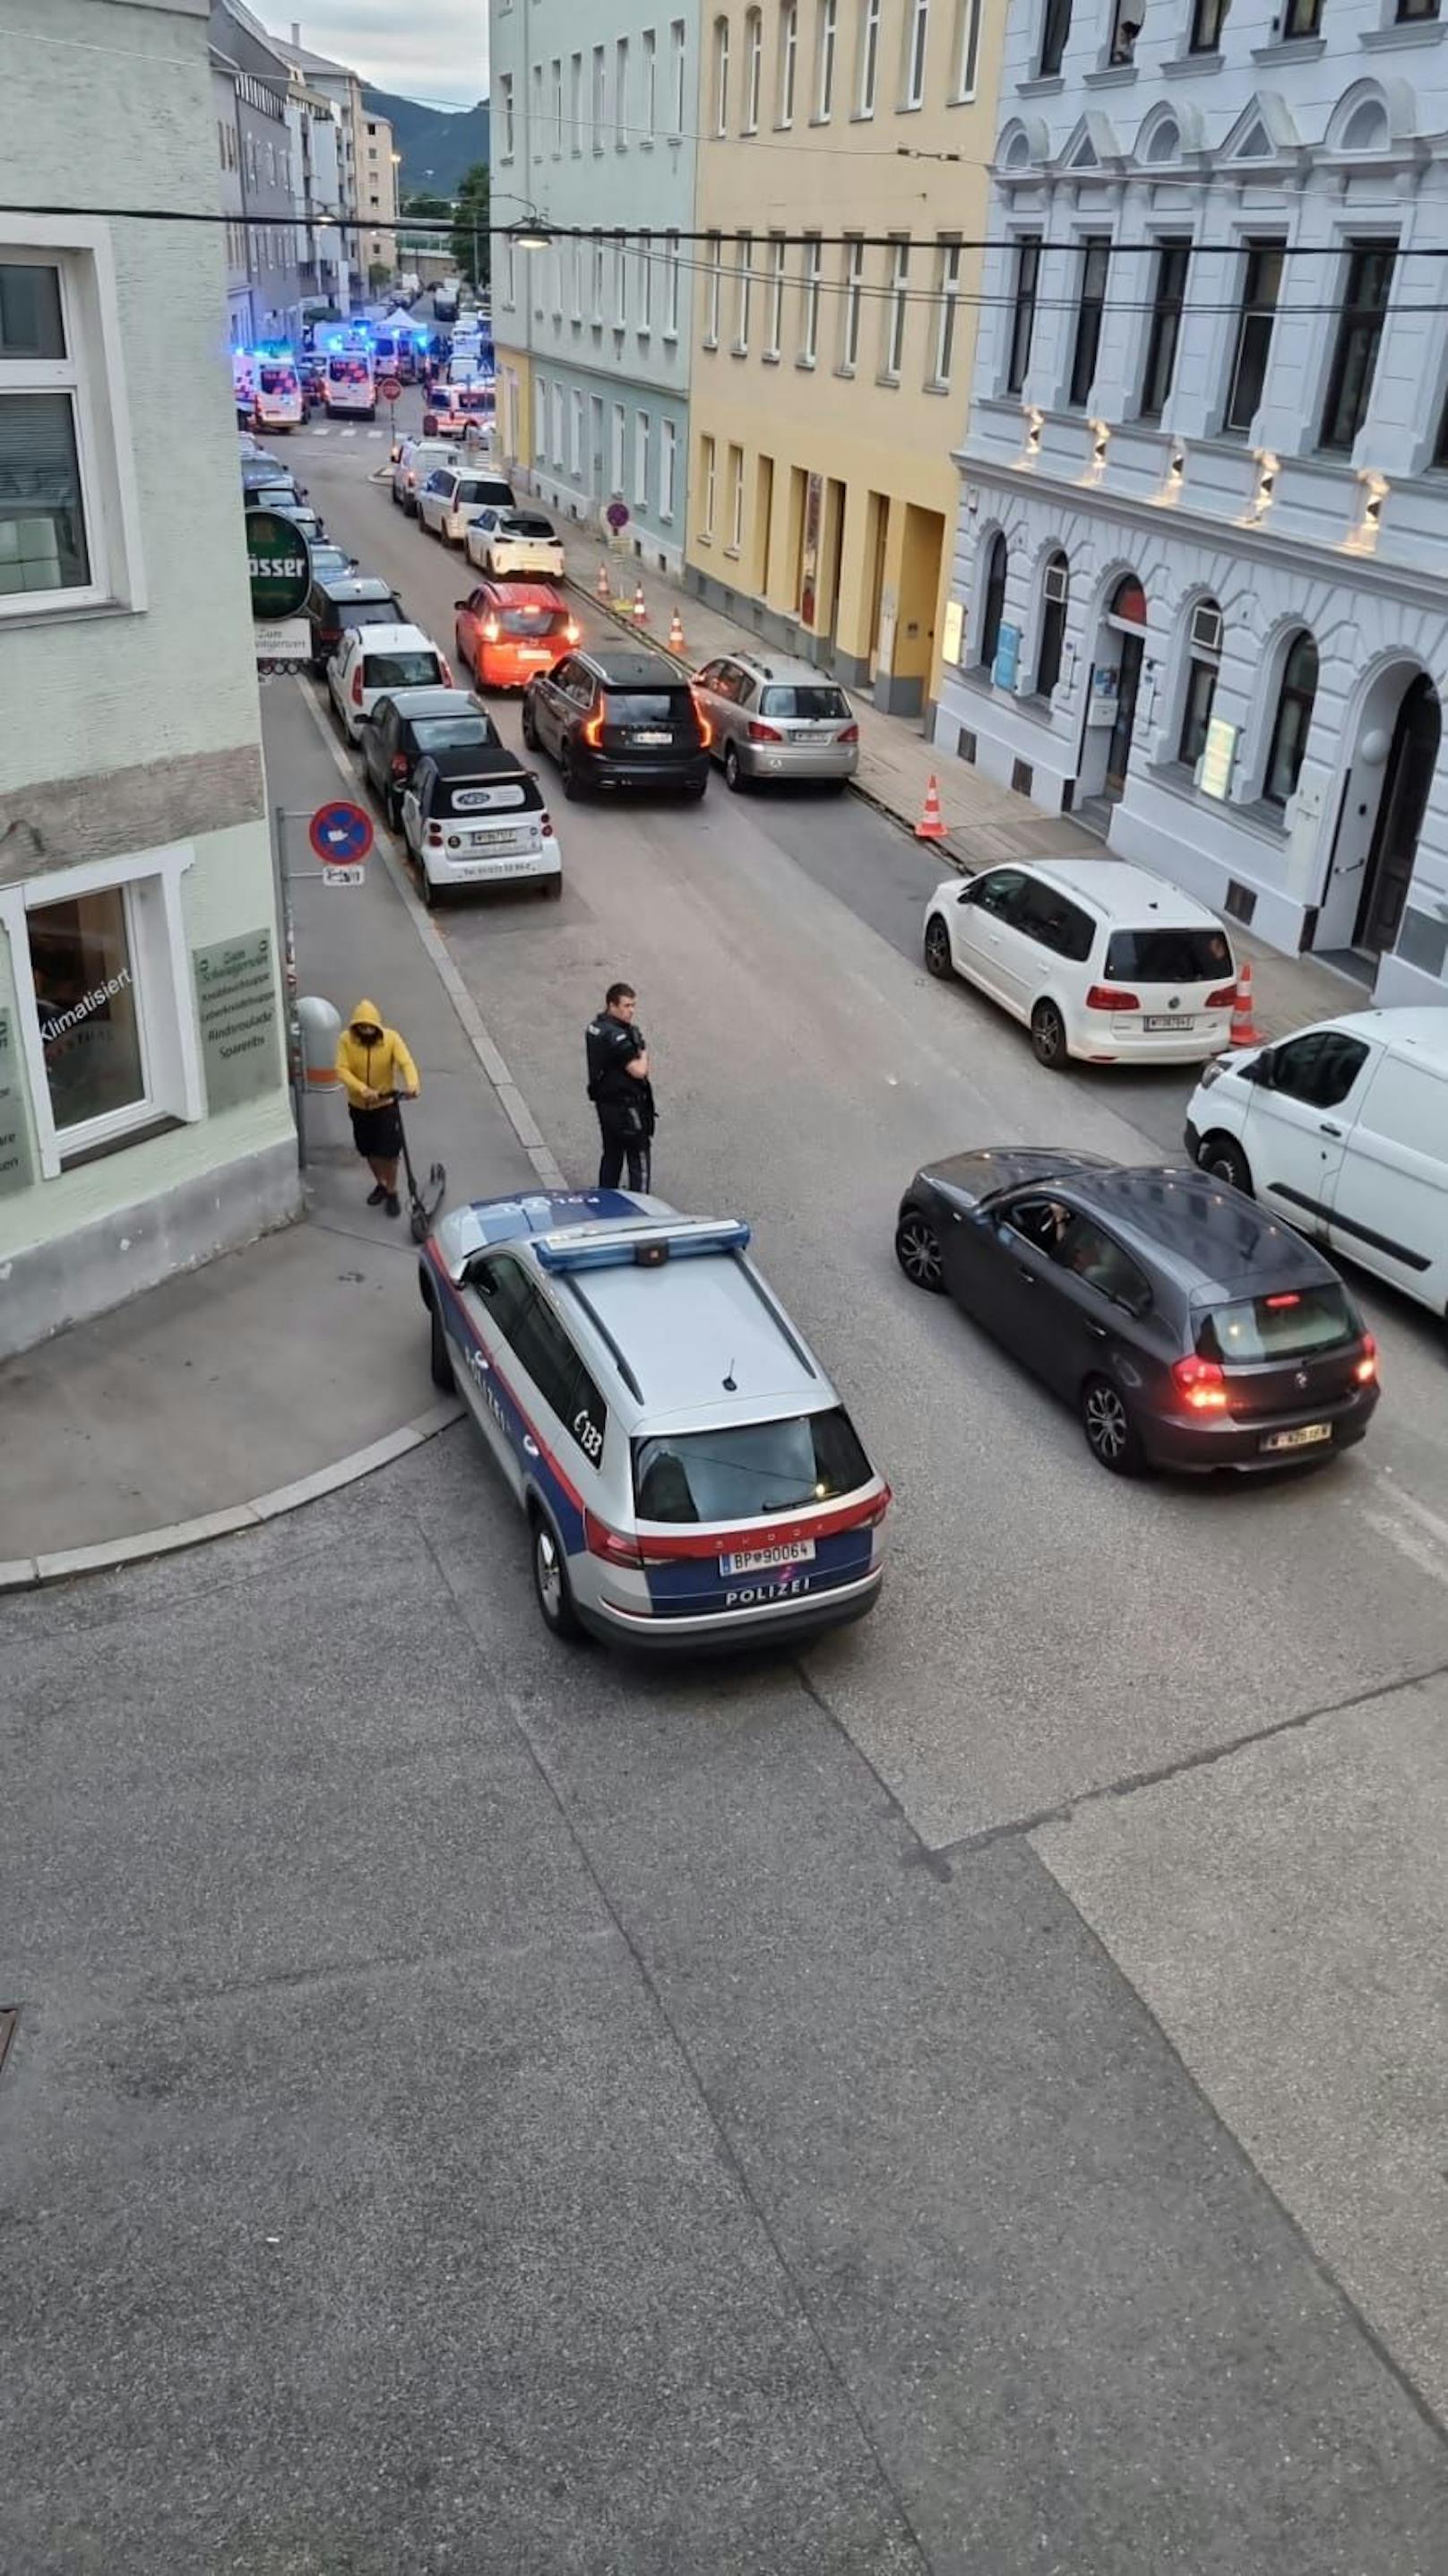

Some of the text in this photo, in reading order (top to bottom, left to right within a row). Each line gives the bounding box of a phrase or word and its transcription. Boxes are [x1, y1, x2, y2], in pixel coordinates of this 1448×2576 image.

[248, 554, 306, 578] össer
[39, 967, 133, 1042] Klimatisiert
[581, 1421, 603, 1456] 133
[763, 1543, 809, 1562] 90064
[726, 1578, 810, 1605] POLIZEI
